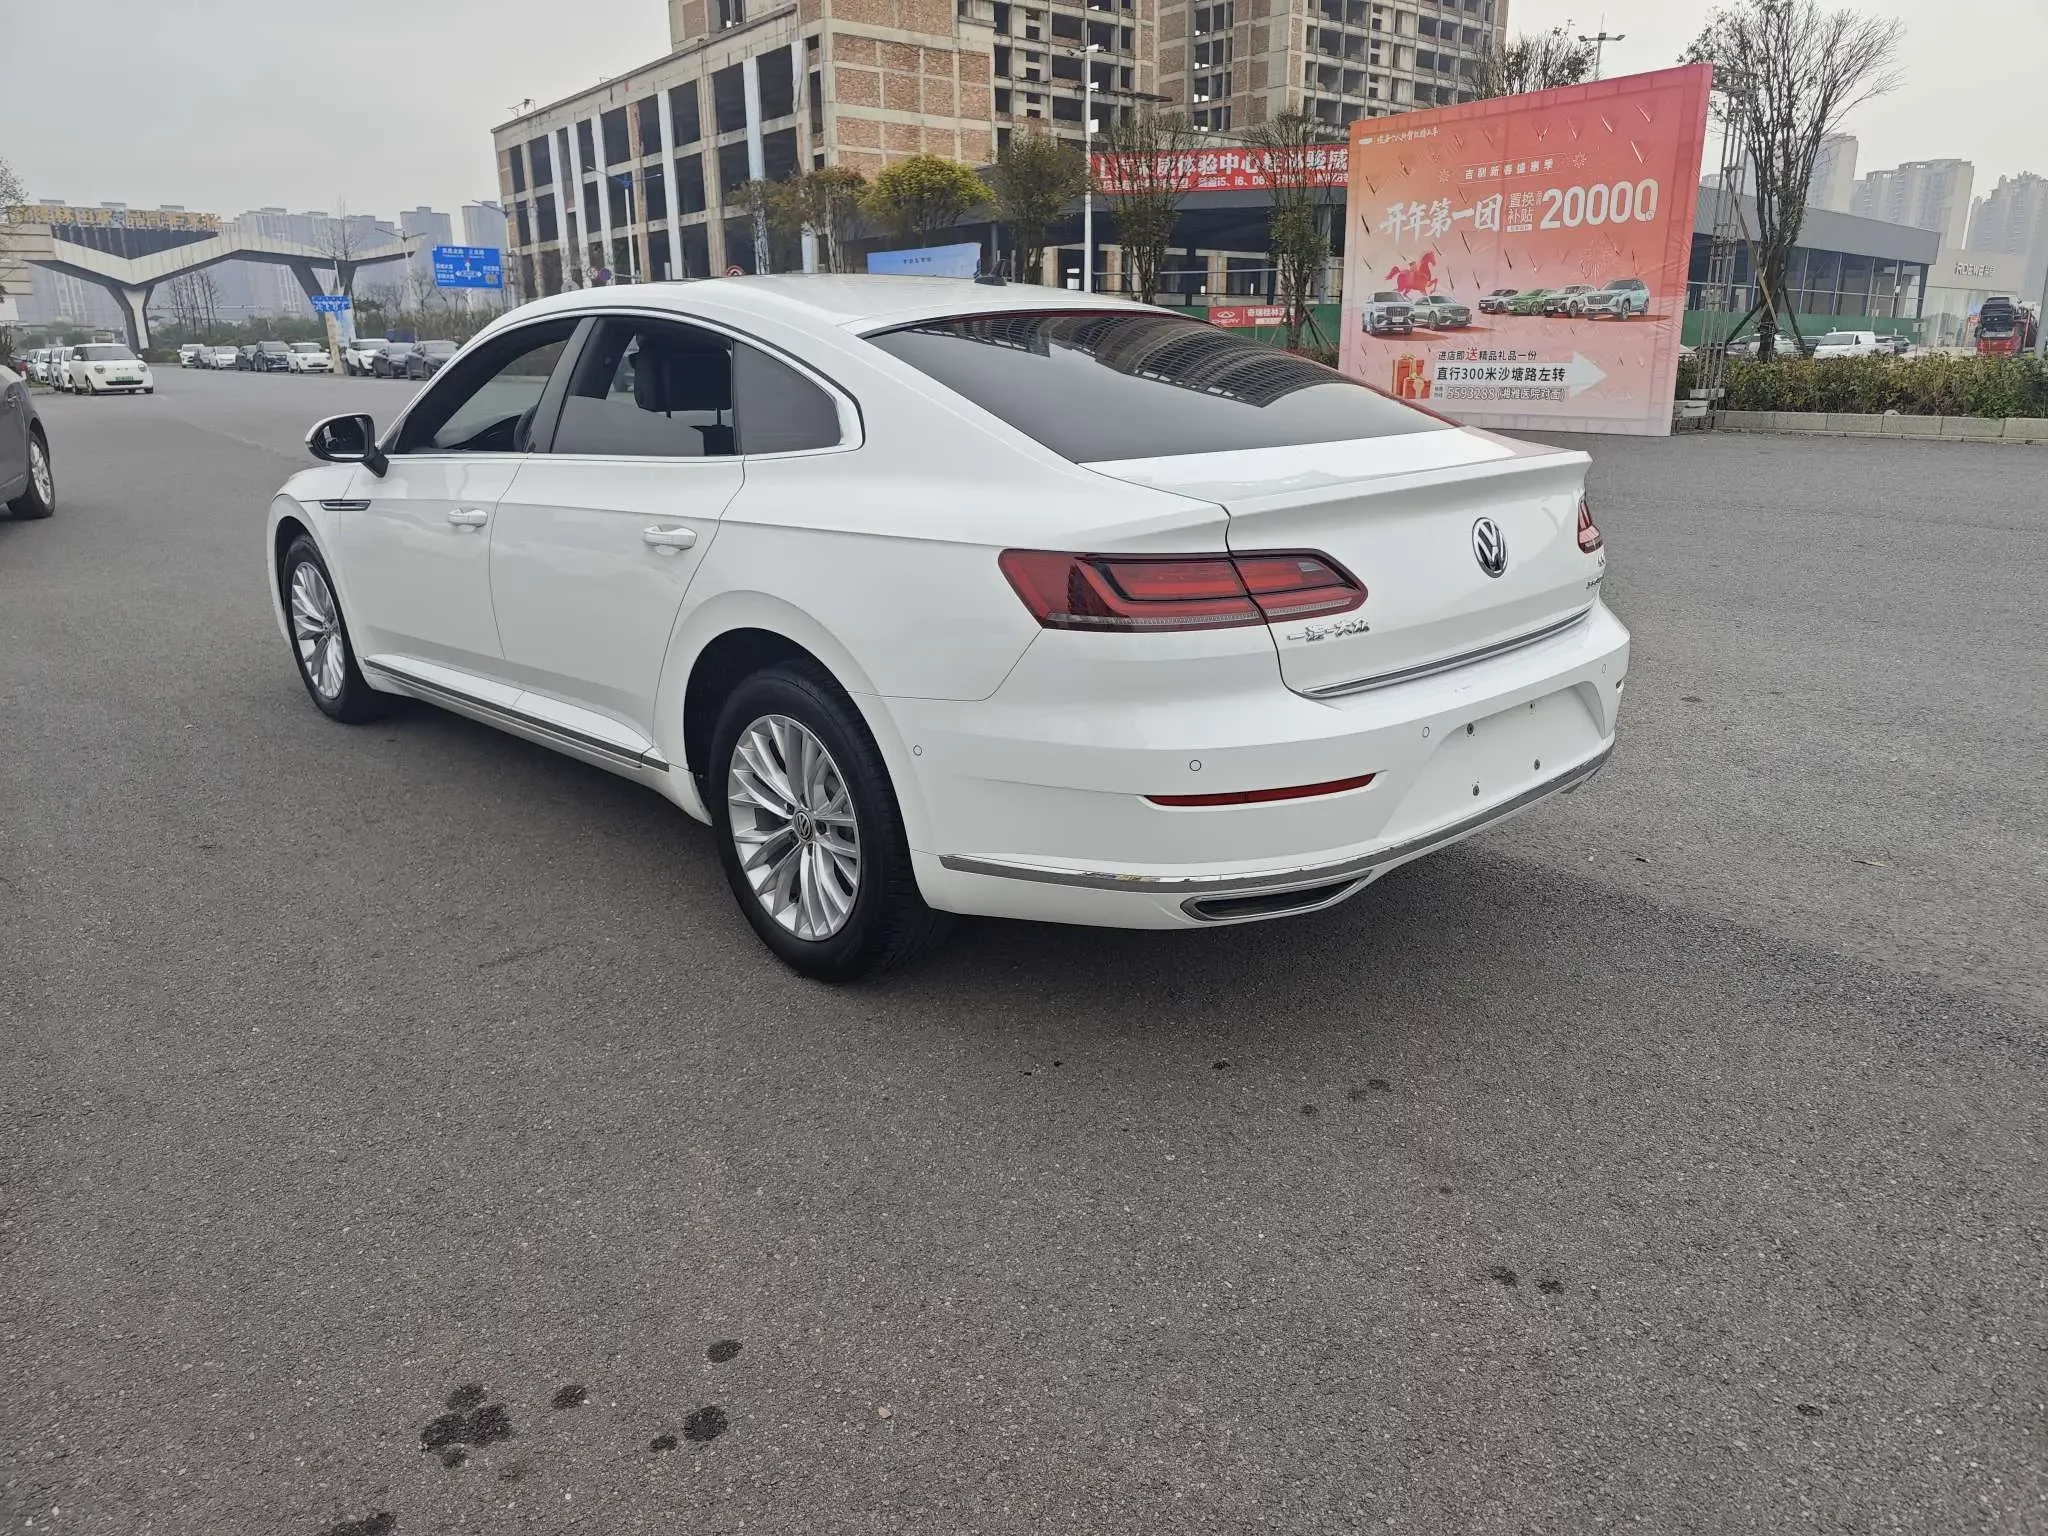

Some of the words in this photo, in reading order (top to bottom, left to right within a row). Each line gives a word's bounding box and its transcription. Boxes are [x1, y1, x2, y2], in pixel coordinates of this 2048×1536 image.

[1380, 191, 1503, 246] 开年第一团
[1539, 178, 1659, 230] 20000
[1437, 346, 1537, 361] 进店即送精品礼品一份
[1436, 366, 1566, 382] 直行300米沙塘路左转
